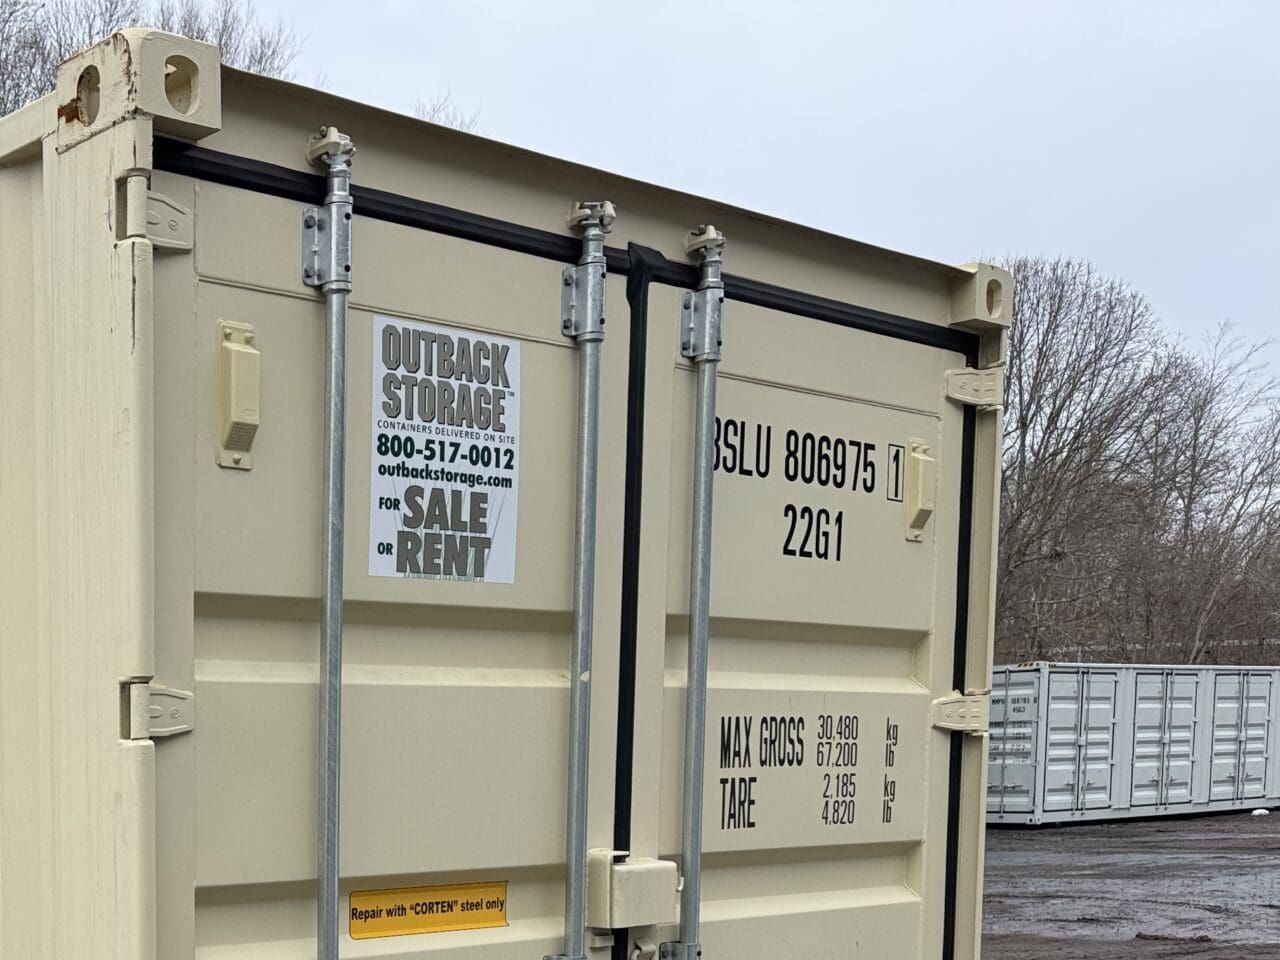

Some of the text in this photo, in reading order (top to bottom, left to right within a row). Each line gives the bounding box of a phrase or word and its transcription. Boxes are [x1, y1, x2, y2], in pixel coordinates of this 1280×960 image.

[381, 323, 510, 388] OUTBACK
[381, 371, 506, 433] STORAGE
[377, 420, 516, 444] CONTAINERS DELIVERED ON SITE
[377, 433, 514, 470] 800-517-0012
[378, 461, 512, 488] outbackstorage.com
[784, 429, 876, 493] 806975
[890, 446, 902, 499] 1
[378, 485, 488, 534] FOR SALE
[783, 504, 843, 561] 22G1
[377, 530, 491, 578] OR RENT
[720, 715, 898, 768] MAX GROSS 30,480 kg
[816, 742, 894, 767] 67,200 lb
[719, 773, 896, 829] TARE 2,185 kg
[821, 800, 892, 825] 4,820 lb
[351, 905, 383, 922] Repair
[386, 904, 406, 918] with
[460, 898, 483, 912] steel
[486, 897, 505, 912] only
